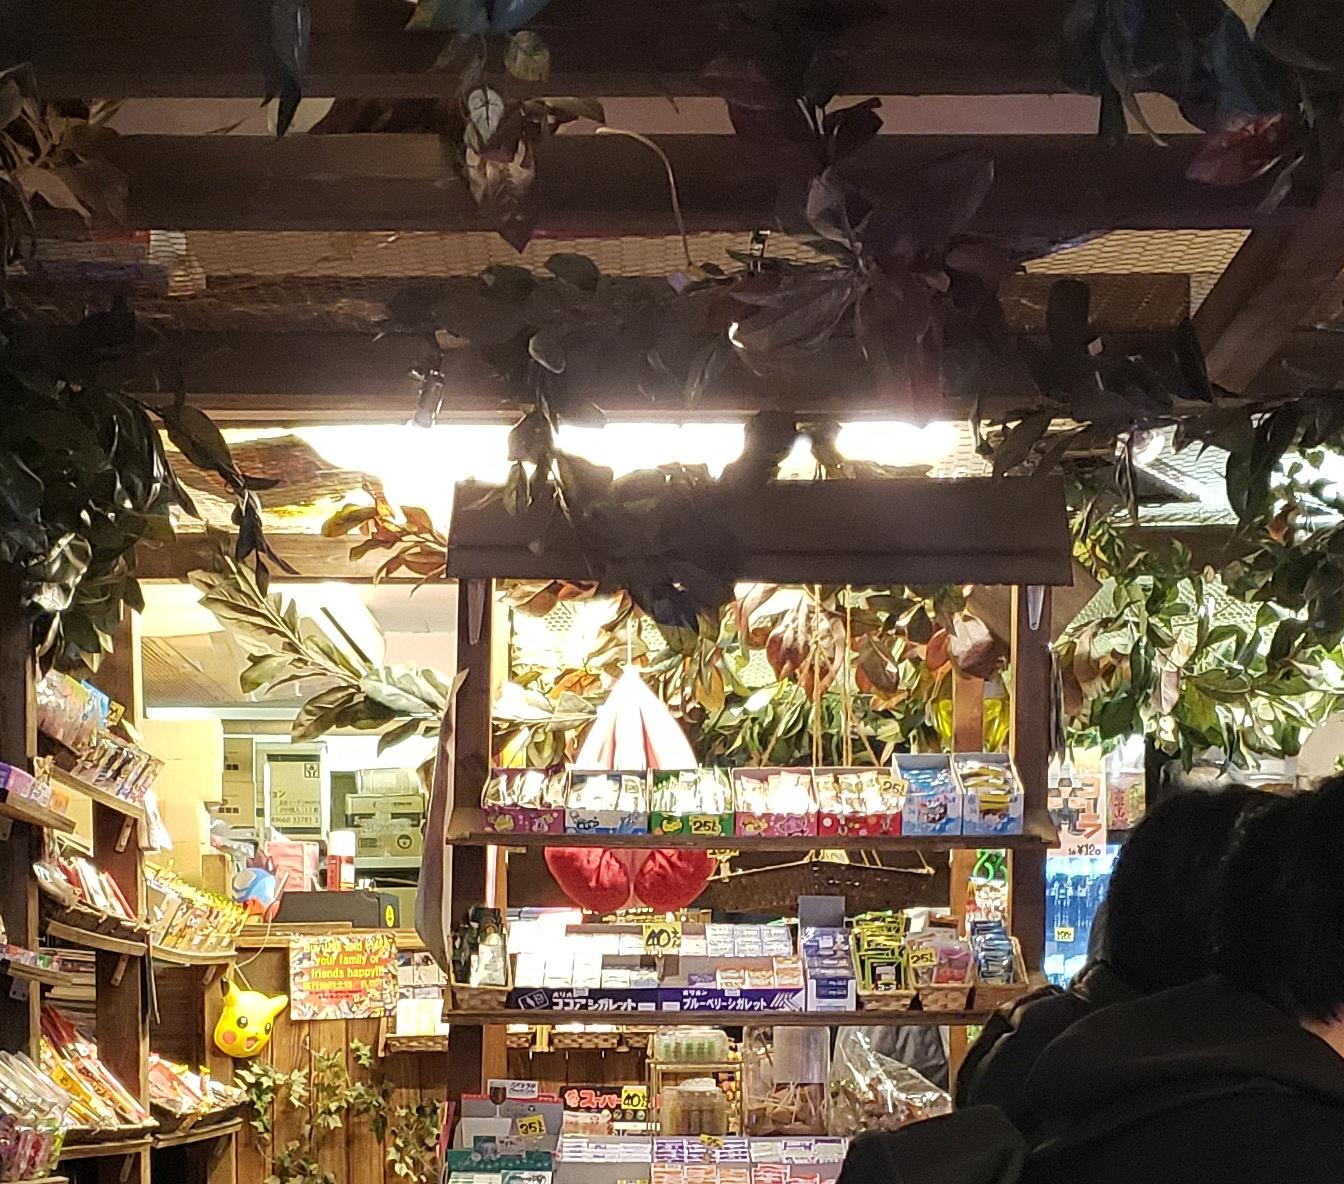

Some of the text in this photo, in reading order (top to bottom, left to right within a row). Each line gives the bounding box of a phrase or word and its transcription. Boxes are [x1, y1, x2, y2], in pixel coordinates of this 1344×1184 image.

[316, 954, 336, 966] your
[339, 953, 367, 965] family
[311, 967, 344, 979] friends
[552, 998, 636, 1011] ココアシガレット
[683, 997, 767, 1011] ブルーベリーシガレット
